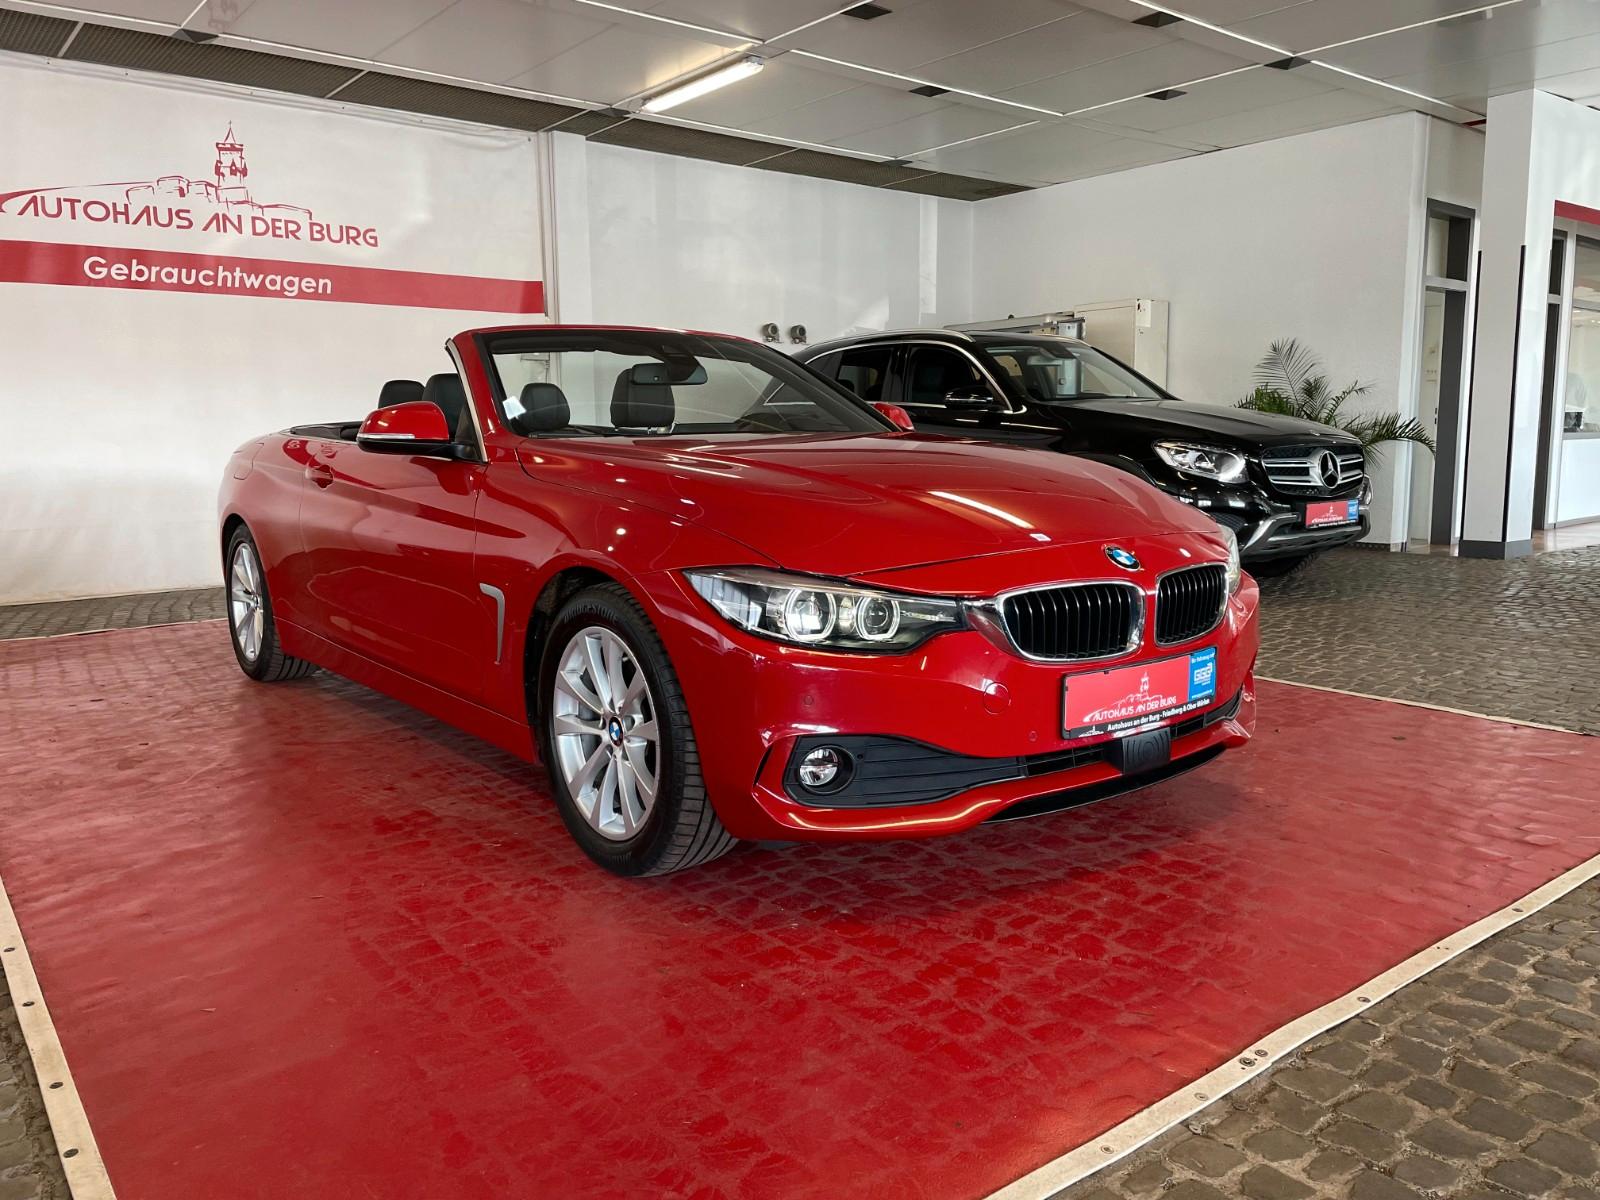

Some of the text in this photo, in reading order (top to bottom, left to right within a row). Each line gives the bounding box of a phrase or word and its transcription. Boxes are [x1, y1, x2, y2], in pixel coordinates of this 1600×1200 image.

[17, 194, 379, 248] AUTOHAUS AN DER BURG
[83, 256, 332, 296] Gebrauchtwagen
[1091, 695, 1177, 722] AUTOHAUS AN DER BURG
[1107, 719, 1133, 732] Autohaus
[1140, 716, 1149, 724] der
[1149, 713, 1160, 722] Burg
